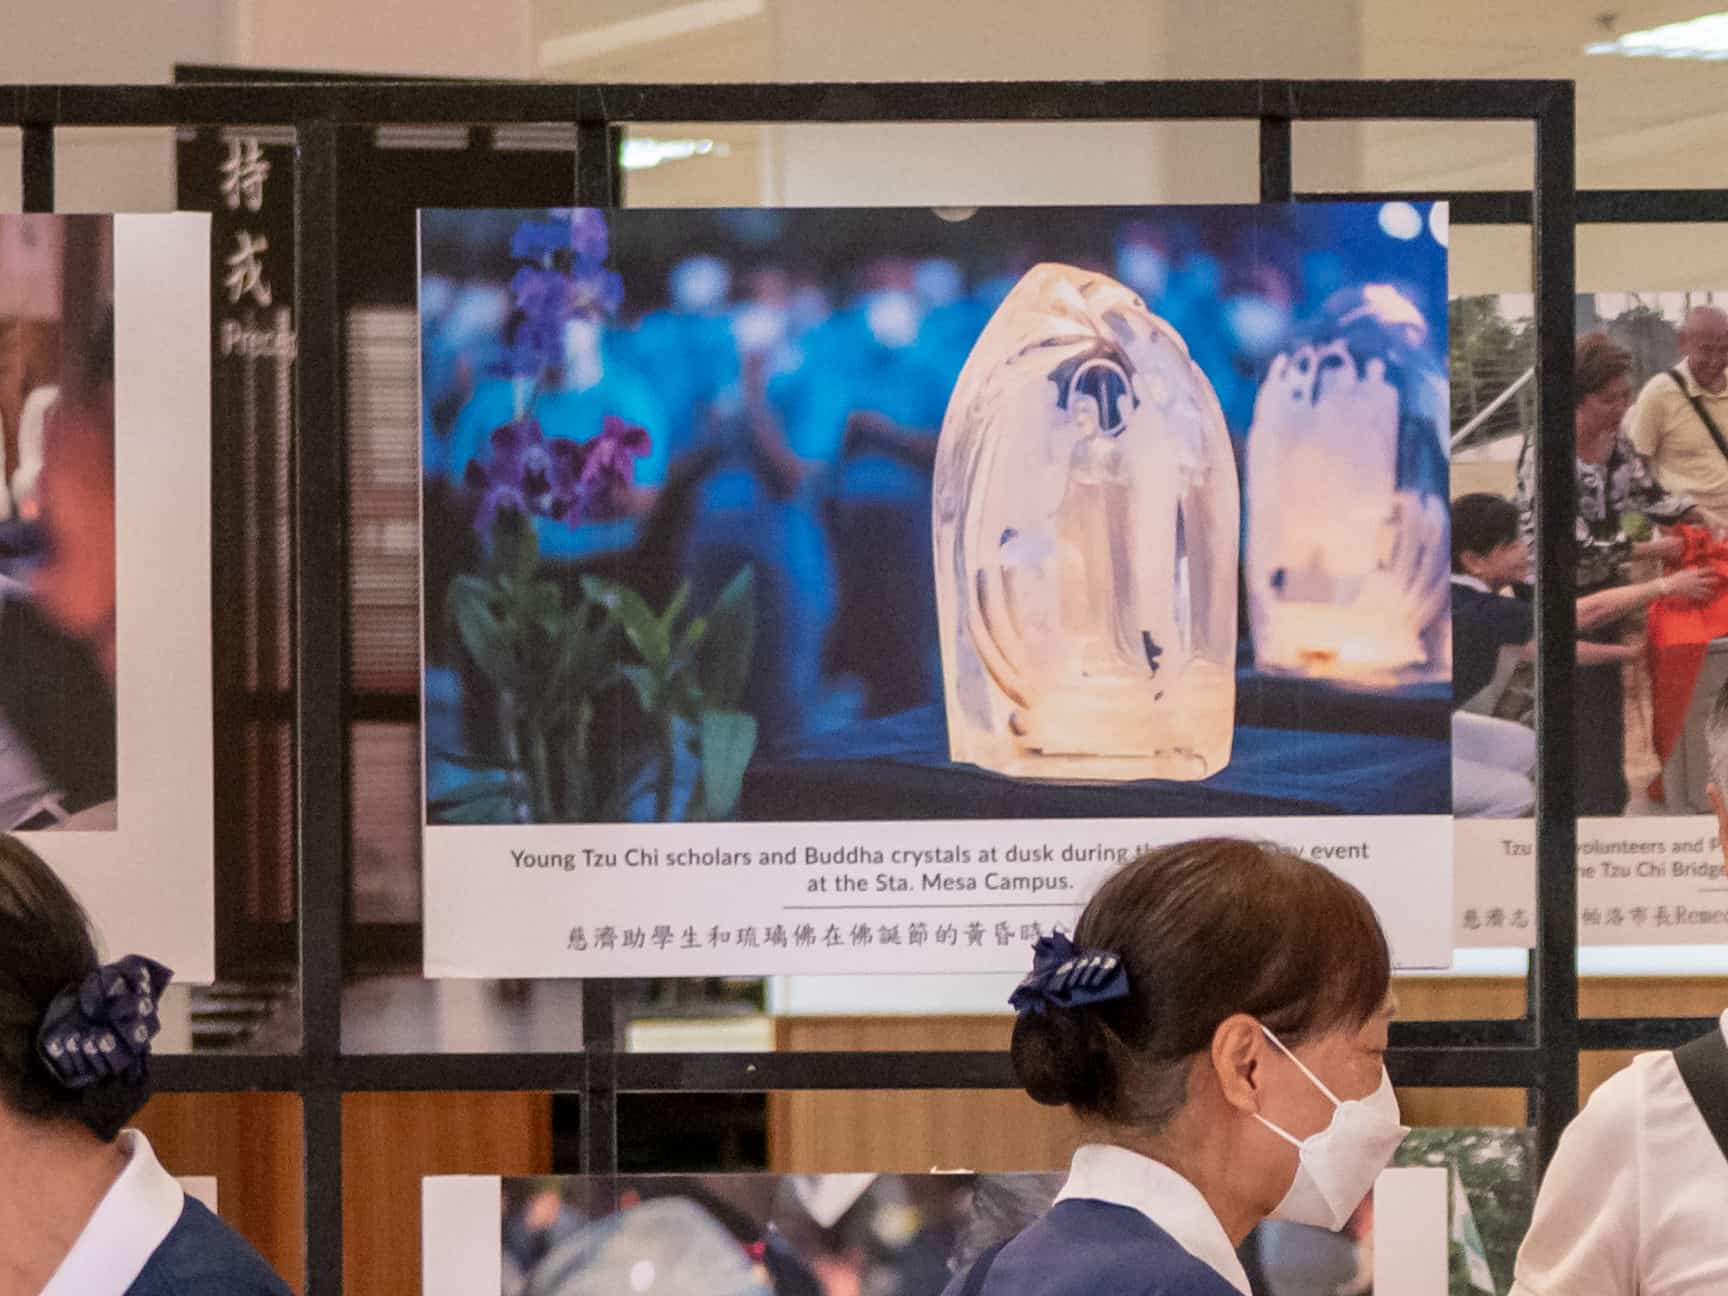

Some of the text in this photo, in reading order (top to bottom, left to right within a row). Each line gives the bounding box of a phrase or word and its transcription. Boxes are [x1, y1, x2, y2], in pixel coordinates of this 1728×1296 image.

[1501, 839, 1533, 856] Tzu
[1672, 837, 1704, 853] and
[511, 849, 576, 872] Young
[582, 849, 617, 867] Tzu
[625, 848, 659, 867] Chi
[666, 848, 752, 867] scholars
[758, 847, 796, 865] and
[805, 846, 884, 865] Buddha
[891, 845, 971, 867] crystals
[978, 847, 999, 864] at
[1006, 844, 1053, 863] dusk
[1311, 842, 1369, 860] event
[1601, 862, 1632, 879] Tzu
[1636, 861, 1666, 878] Chi
[807, 872, 1074, 893] at the Sta. Mesa Campus.
